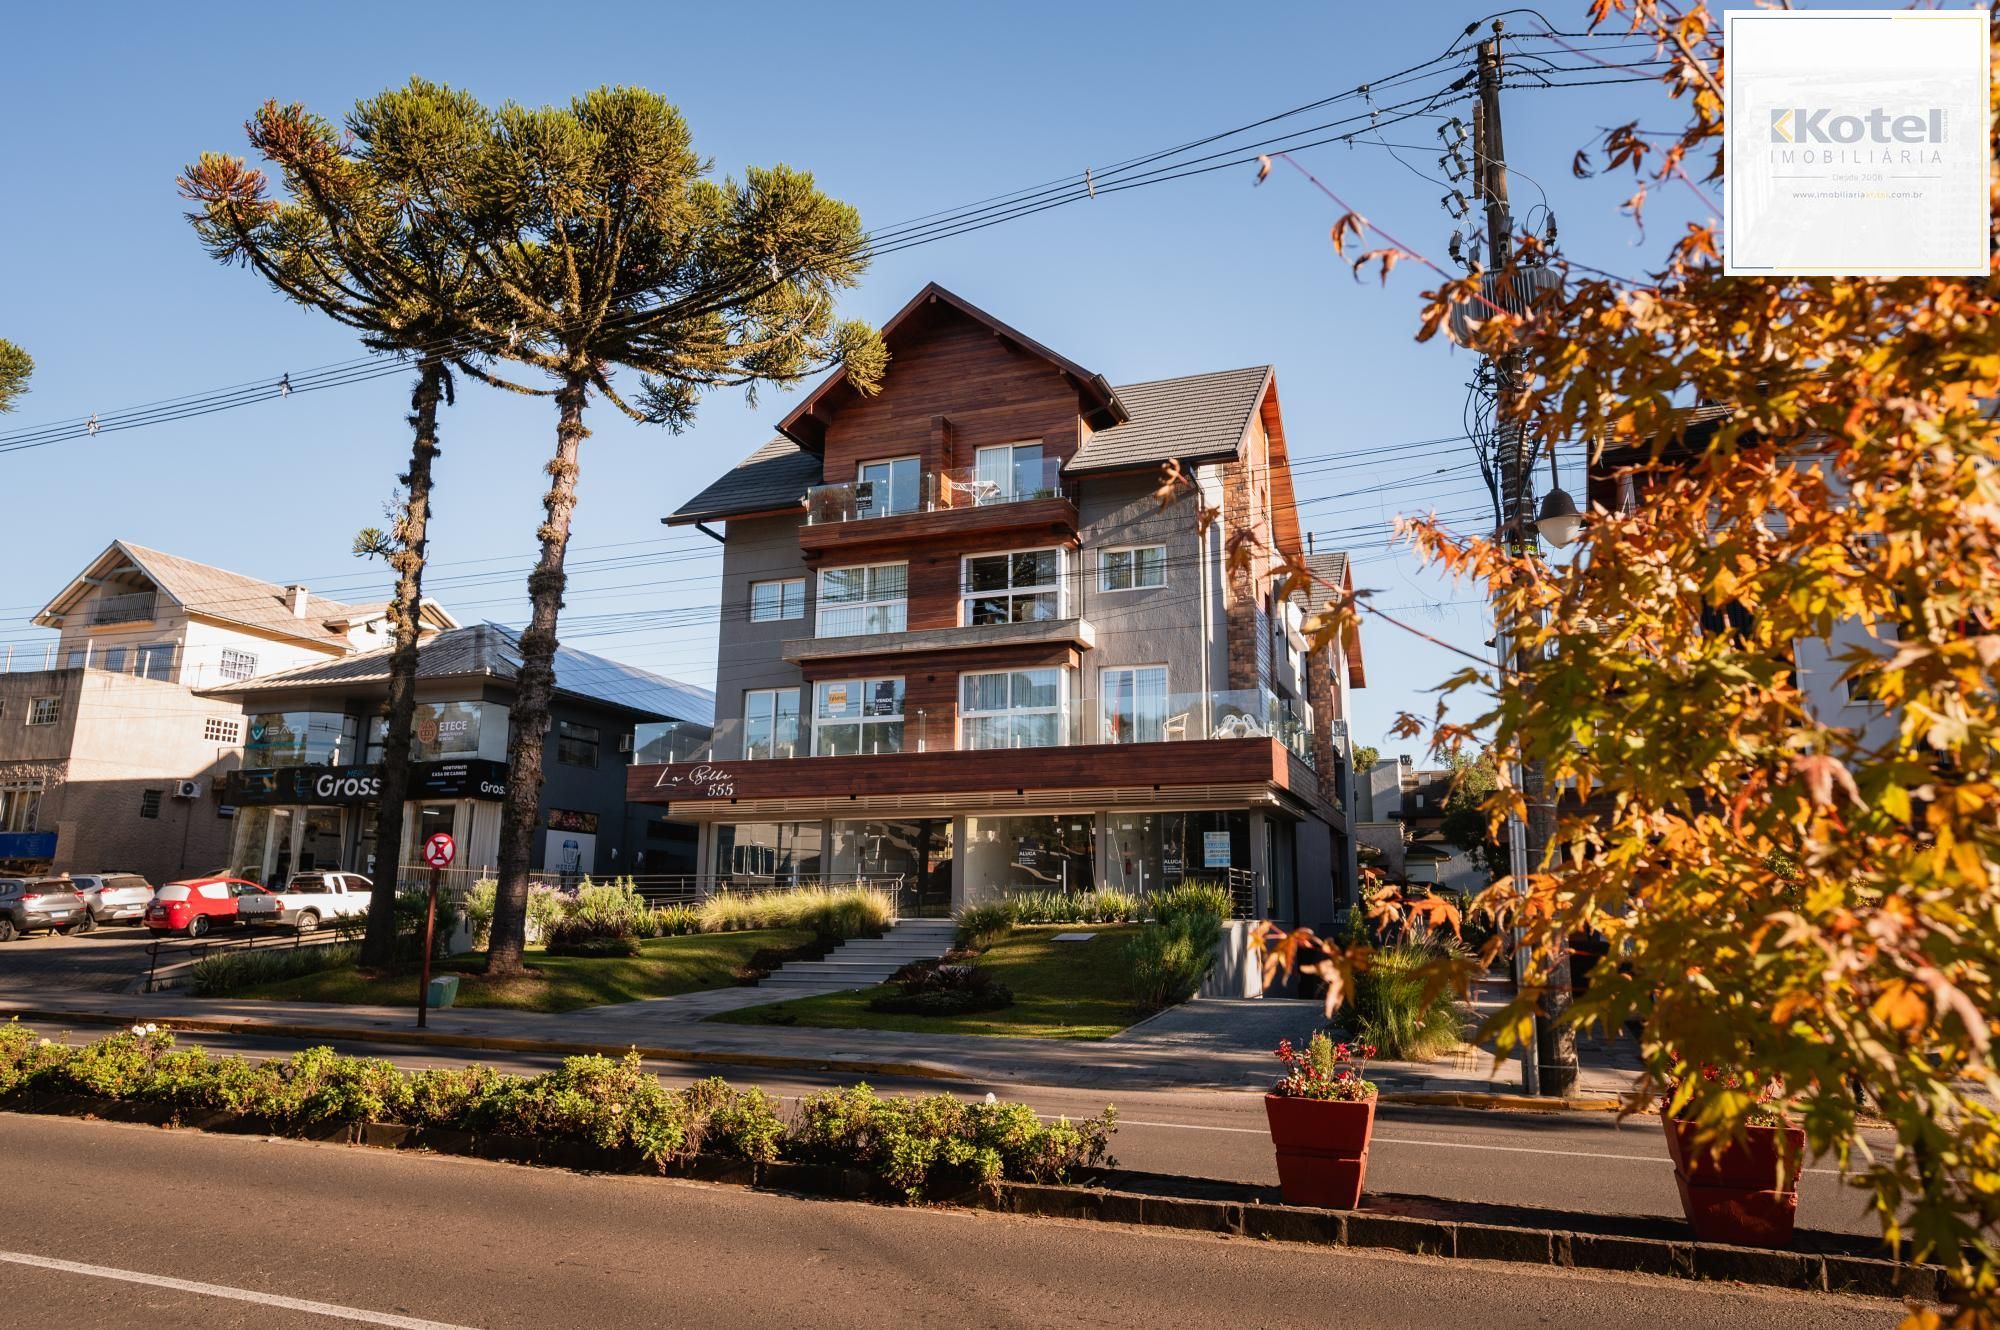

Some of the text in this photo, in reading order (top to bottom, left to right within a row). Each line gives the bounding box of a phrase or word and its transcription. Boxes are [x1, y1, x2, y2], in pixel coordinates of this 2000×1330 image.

[439, 720, 468, 731] ETECE
[654, 766, 684, 787] La
[707, 782, 734, 797] 555
